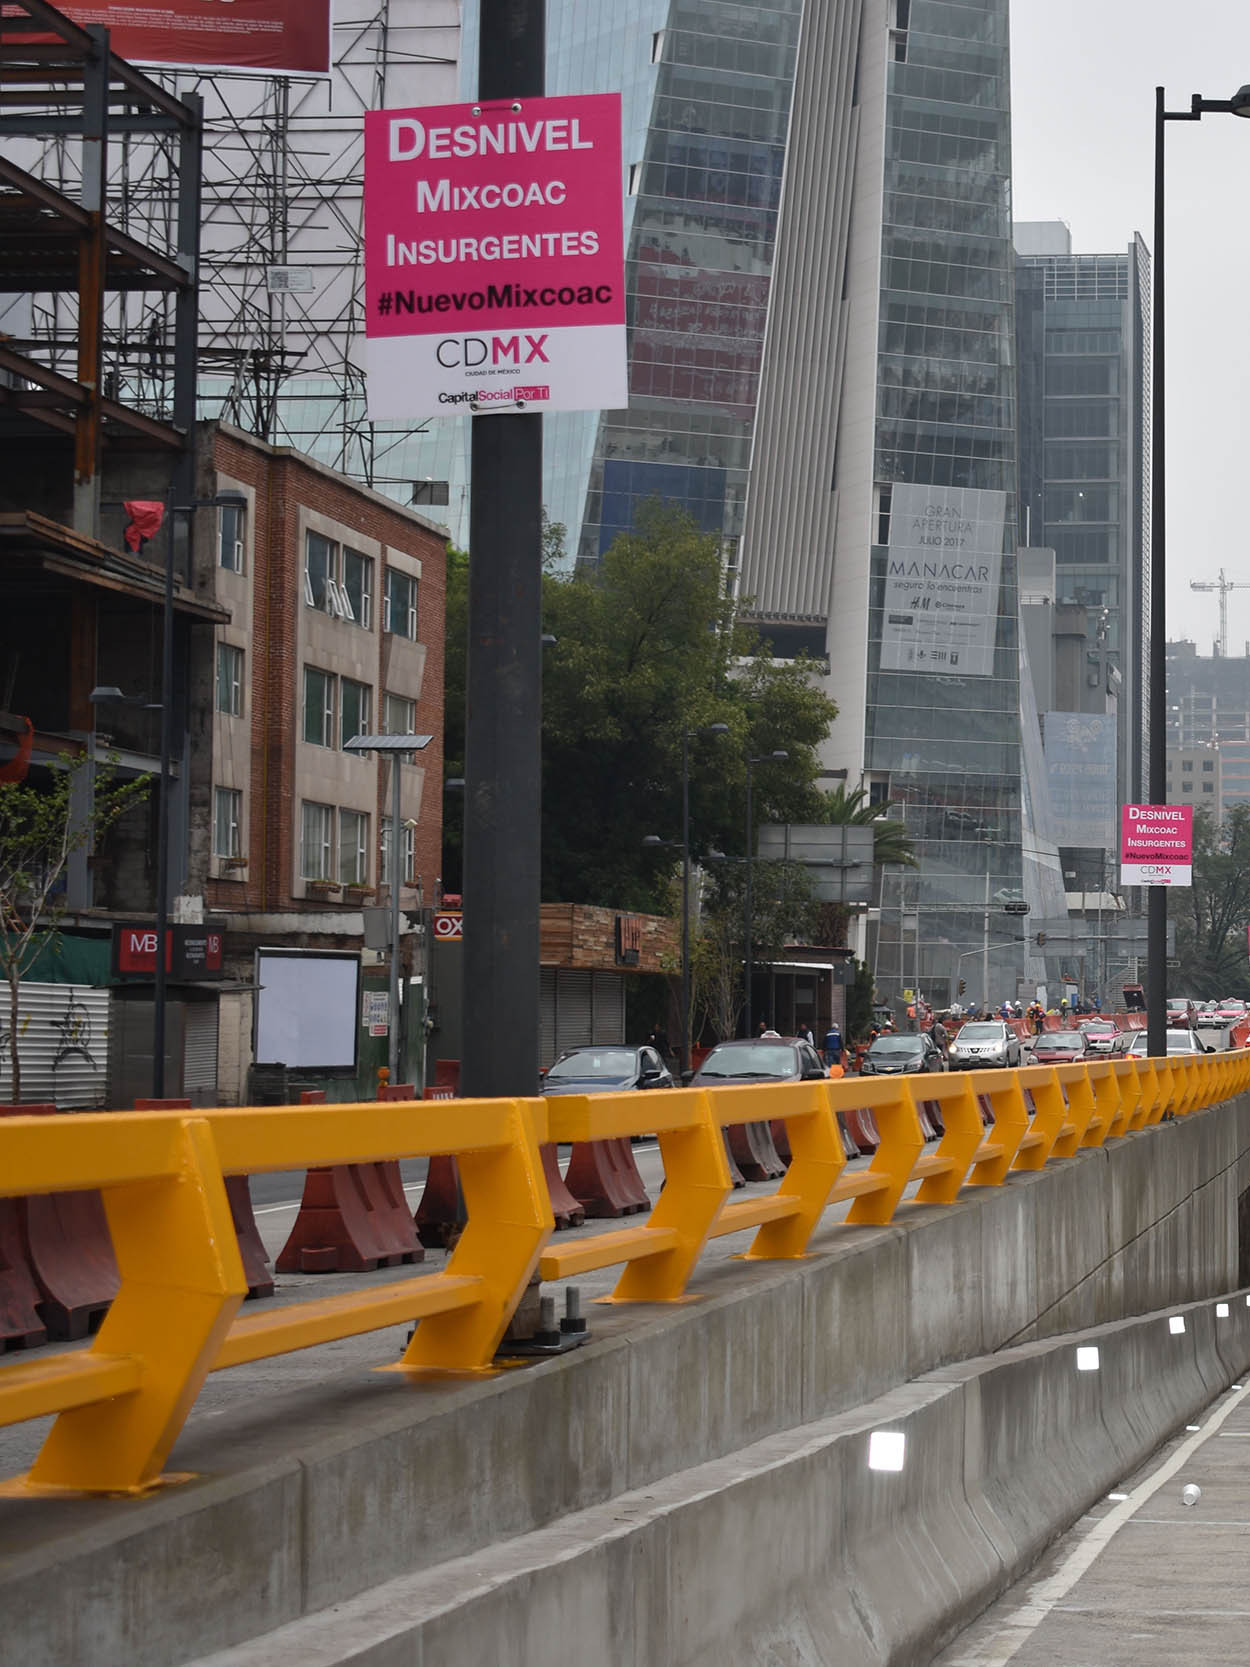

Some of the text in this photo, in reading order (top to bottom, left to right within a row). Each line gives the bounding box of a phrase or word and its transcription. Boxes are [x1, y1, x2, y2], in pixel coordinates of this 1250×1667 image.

[389, 118, 594, 162] DESNIVEL
[416, 179, 567, 213] MIXCOAC
[386, 231, 600, 267] INSURGENTES
[378, 284, 613, 316] #NuevoMixcoac
[436, 334, 550, 368] CDMX
[924, 505, 961, 518] GRAN
[913, 519, 973, 533] APERTURA
[919, 536, 965, 547] JULIO 2017
[889, 561, 989, 581] MANACAR
[893, 581, 983, 594] seguro lo encuentras
[1128, 807, 1185, 821] DESNIVEL
[1136, 824, 1178, 834] MIXCOAC
[1127, 837, 1186, 848] INSURGENTES
[1125, 852, 1189, 861] #NuevoMixcoac
[1140, 865, 1172, 875] CDMX
[130, 933, 158, 953] MB
